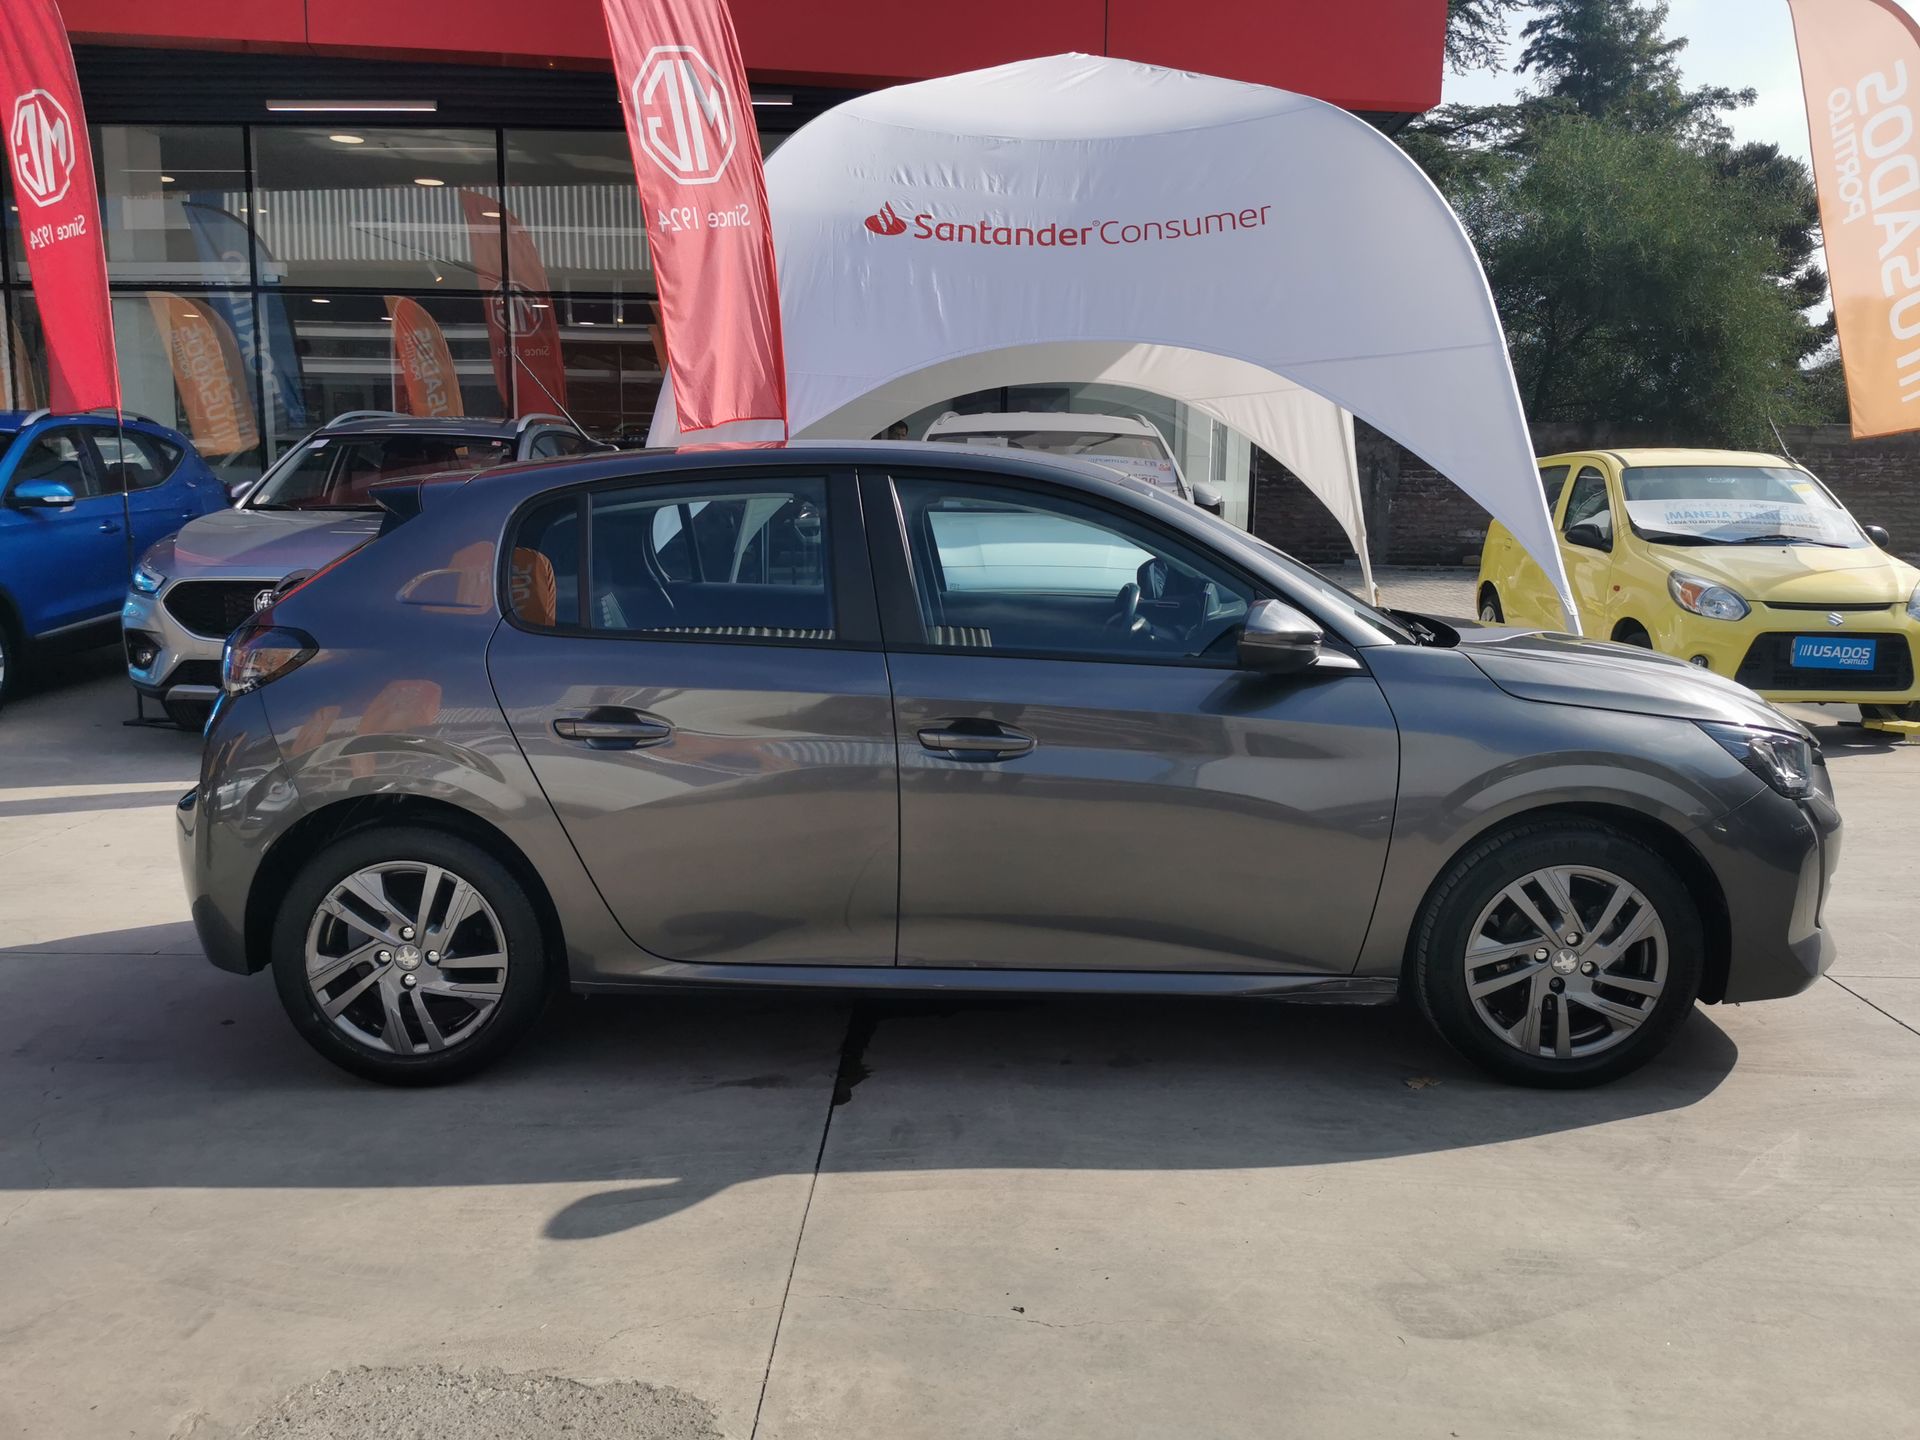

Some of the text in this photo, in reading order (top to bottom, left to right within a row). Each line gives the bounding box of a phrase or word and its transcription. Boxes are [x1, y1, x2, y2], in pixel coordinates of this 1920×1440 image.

[913, 204, 1272, 247] Santander Consumer
[1812, 645, 1872, 659] USADOS
[1839, 658, 1869, 666] PORTILLO
